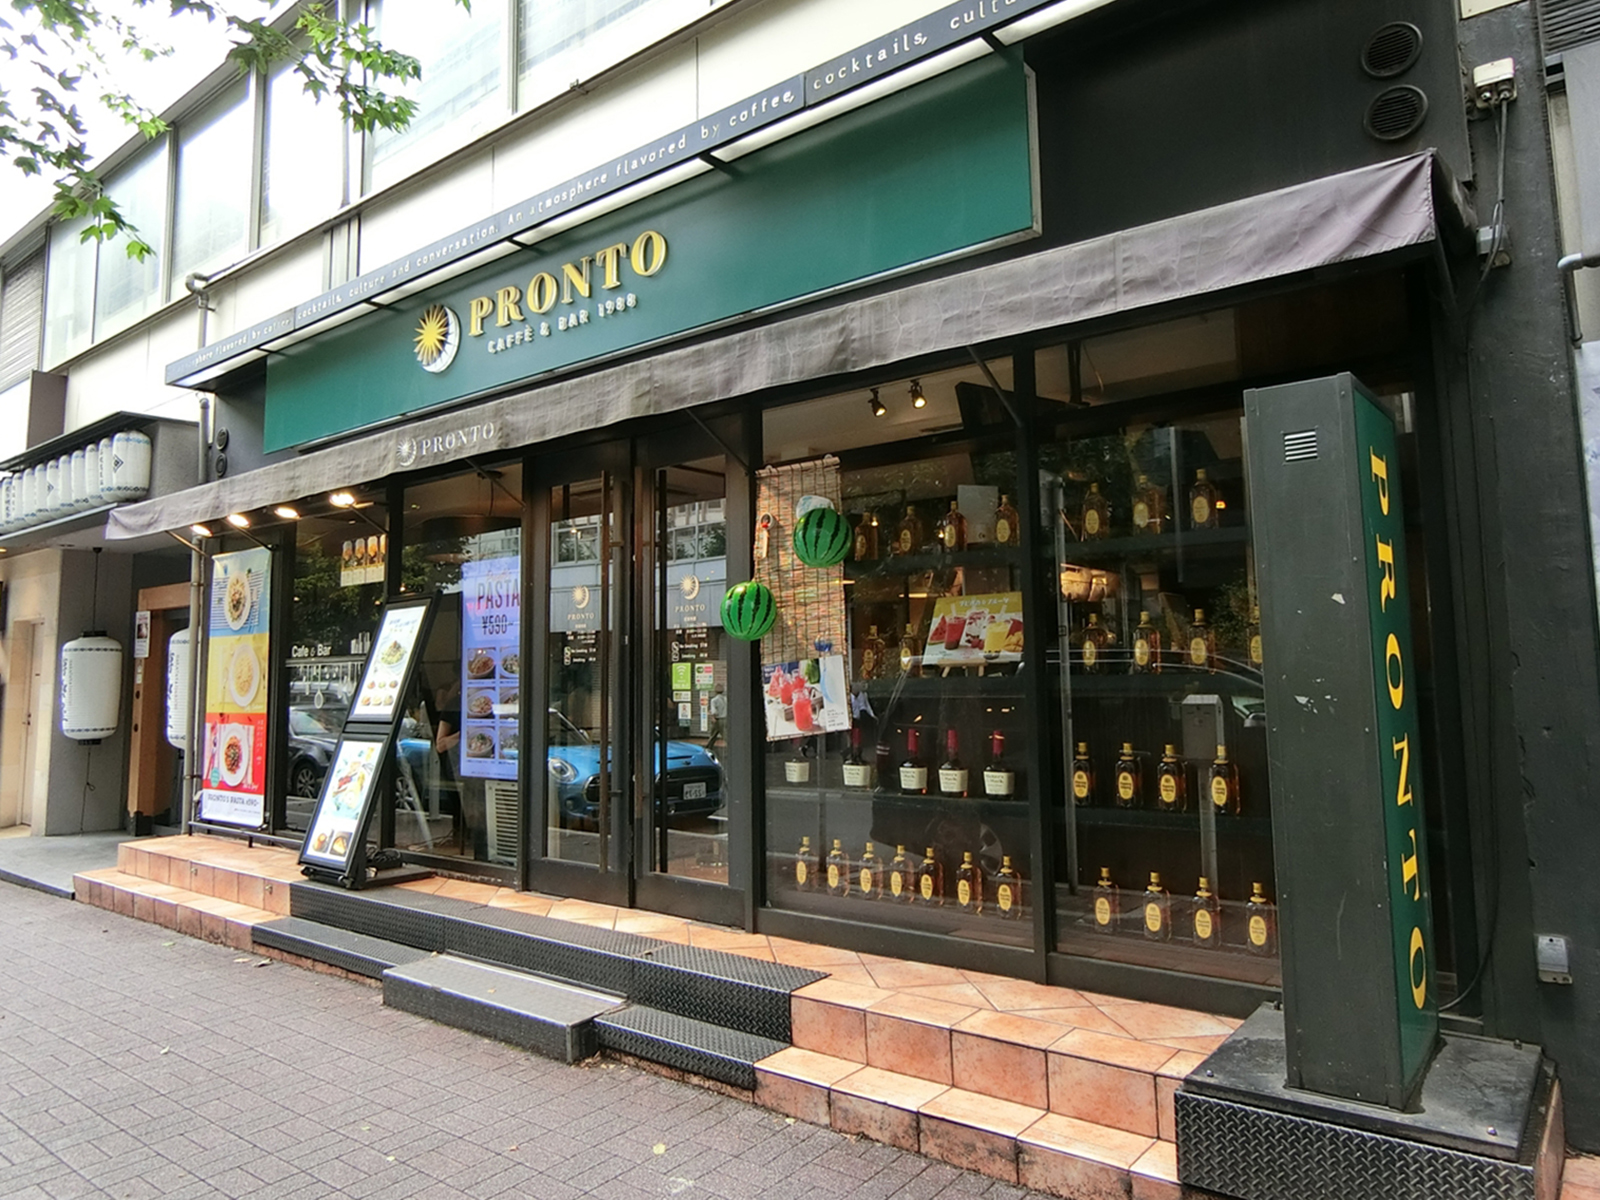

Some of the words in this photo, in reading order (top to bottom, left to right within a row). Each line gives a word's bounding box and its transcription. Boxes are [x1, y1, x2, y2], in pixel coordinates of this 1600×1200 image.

[216, 335, 247, 355] flavored
[252, 330, 261, 341] by
[349, 275, 385, 297] culture
[392, 260, 410, 279] and
[416, 223, 499, 268] conversation.
[508, 210, 523, 225] An
[529, 171, 608, 216] atmosphere
[616, 135, 687, 177] flavored
[701, 125, 720, 142] by
[729, 89, 795, 127] coffee,
[813, 30, 929, 90] cocktails,
[468, 230, 668, 337] PRONTO
[487, 323, 534, 354] CAFFÈ
[540, 321, 551, 337] &
[558, 309, 589, 331] BAR
[597, 292, 638, 318] 1988
[420, 422, 496, 456] PRONTO
[477, 578, 520, 610] PASTA
[674, 603, 706, 613] PRONTO
[567, 612, 595, 621] PRONTO
[291, 644, 309, 657] Cafe
[317, 643, 332, 657] Bar
[1369, 444, 1427, 1011] PRONTO
